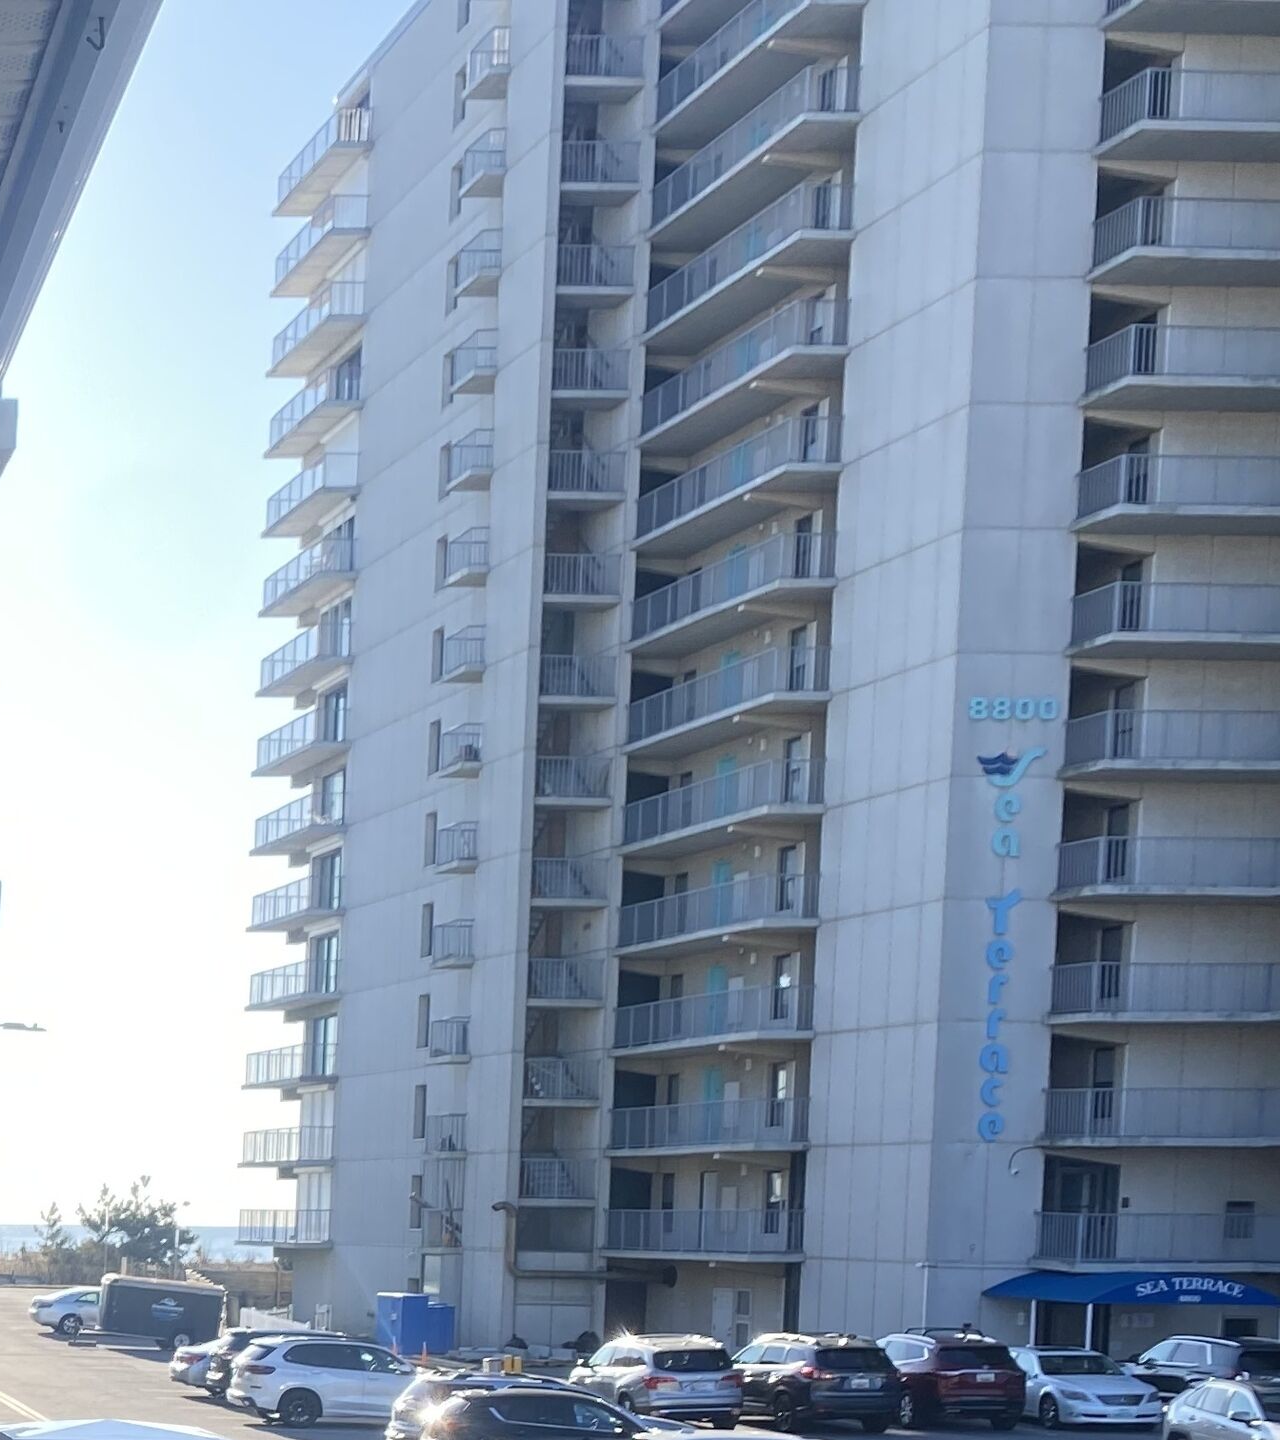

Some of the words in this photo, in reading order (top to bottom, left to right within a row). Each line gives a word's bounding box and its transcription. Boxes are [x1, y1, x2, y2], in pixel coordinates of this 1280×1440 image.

[969, 695, 1058, 720] 8800
[987, 746, 1048, 858] Sea
[978, 888, 1022, 1143] Terrace
[1135, 1280, 1169, 1297] SEA
[1171, 1277, 1245, 1297] TERRACE
